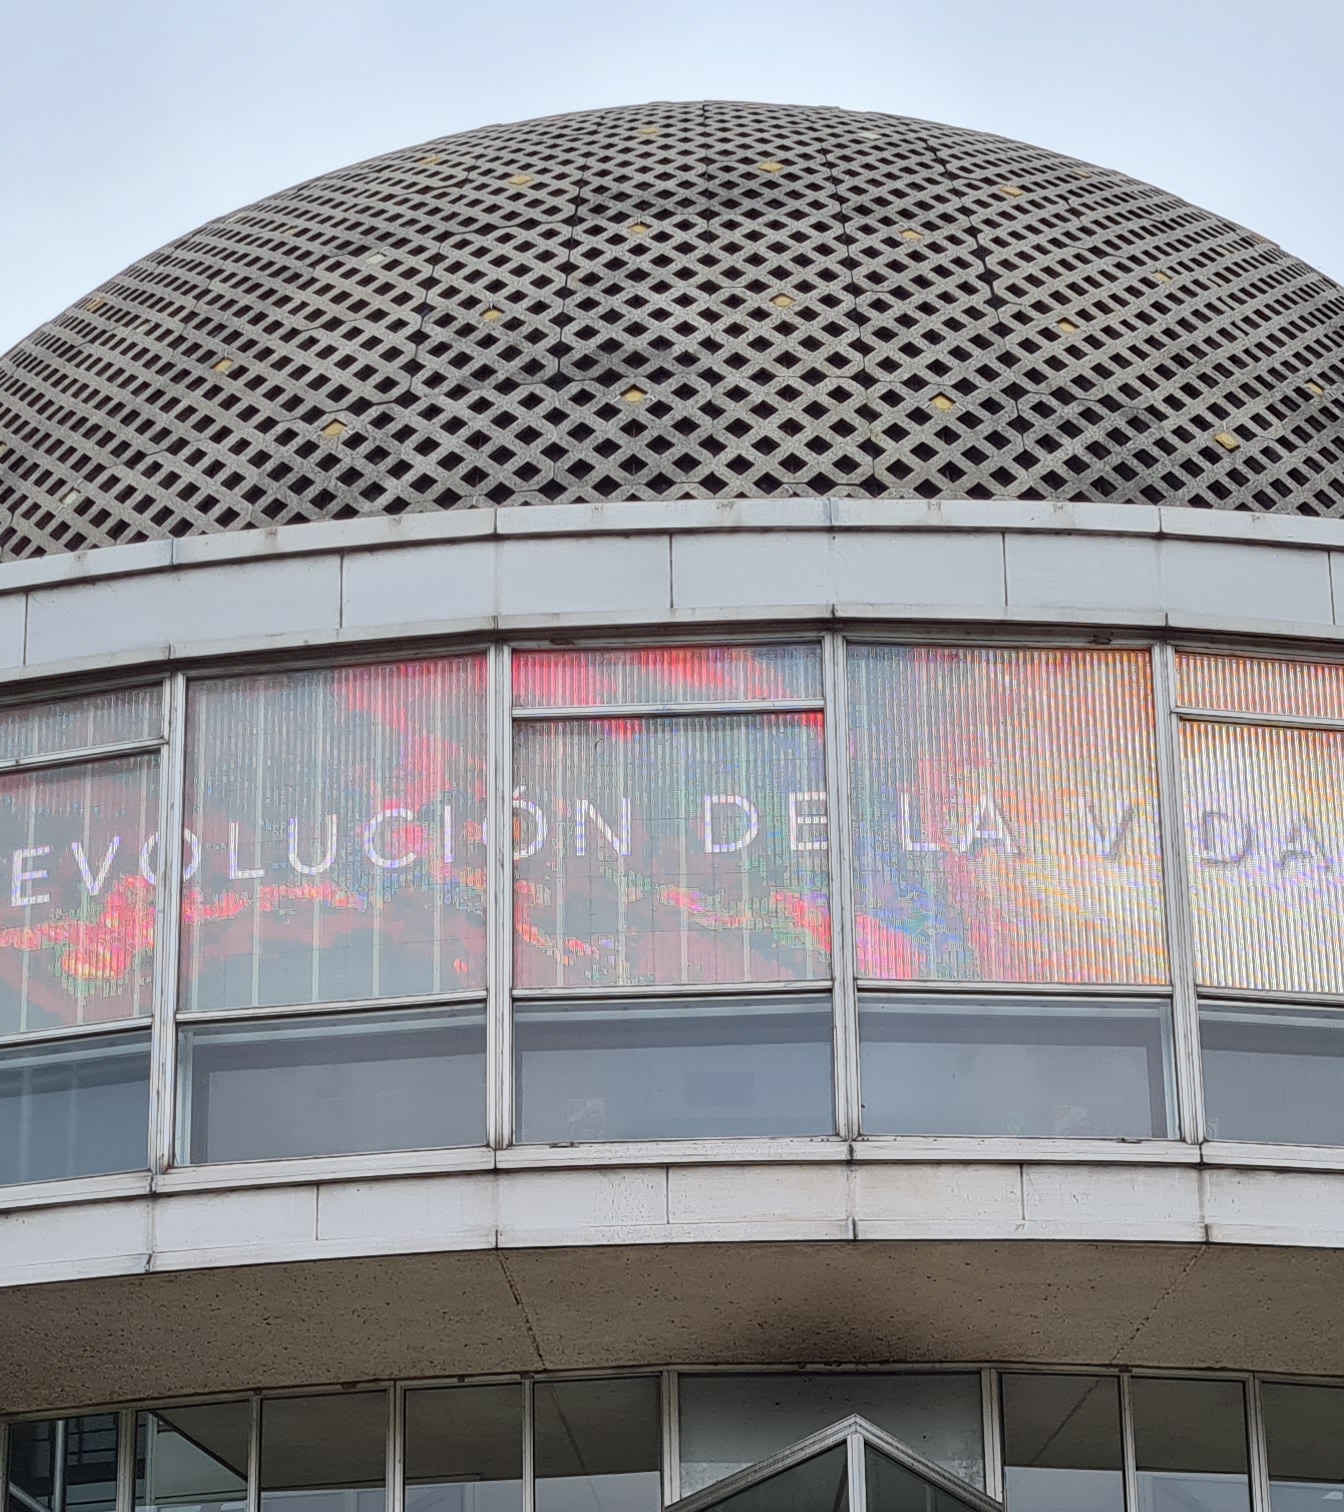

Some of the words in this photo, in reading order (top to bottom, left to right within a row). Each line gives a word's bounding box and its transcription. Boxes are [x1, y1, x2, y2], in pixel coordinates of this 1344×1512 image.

[703, 790, 827, 854] DE
[899, 790, 1018, 854] LA
[1082, 802, 1332, 874] VDA
